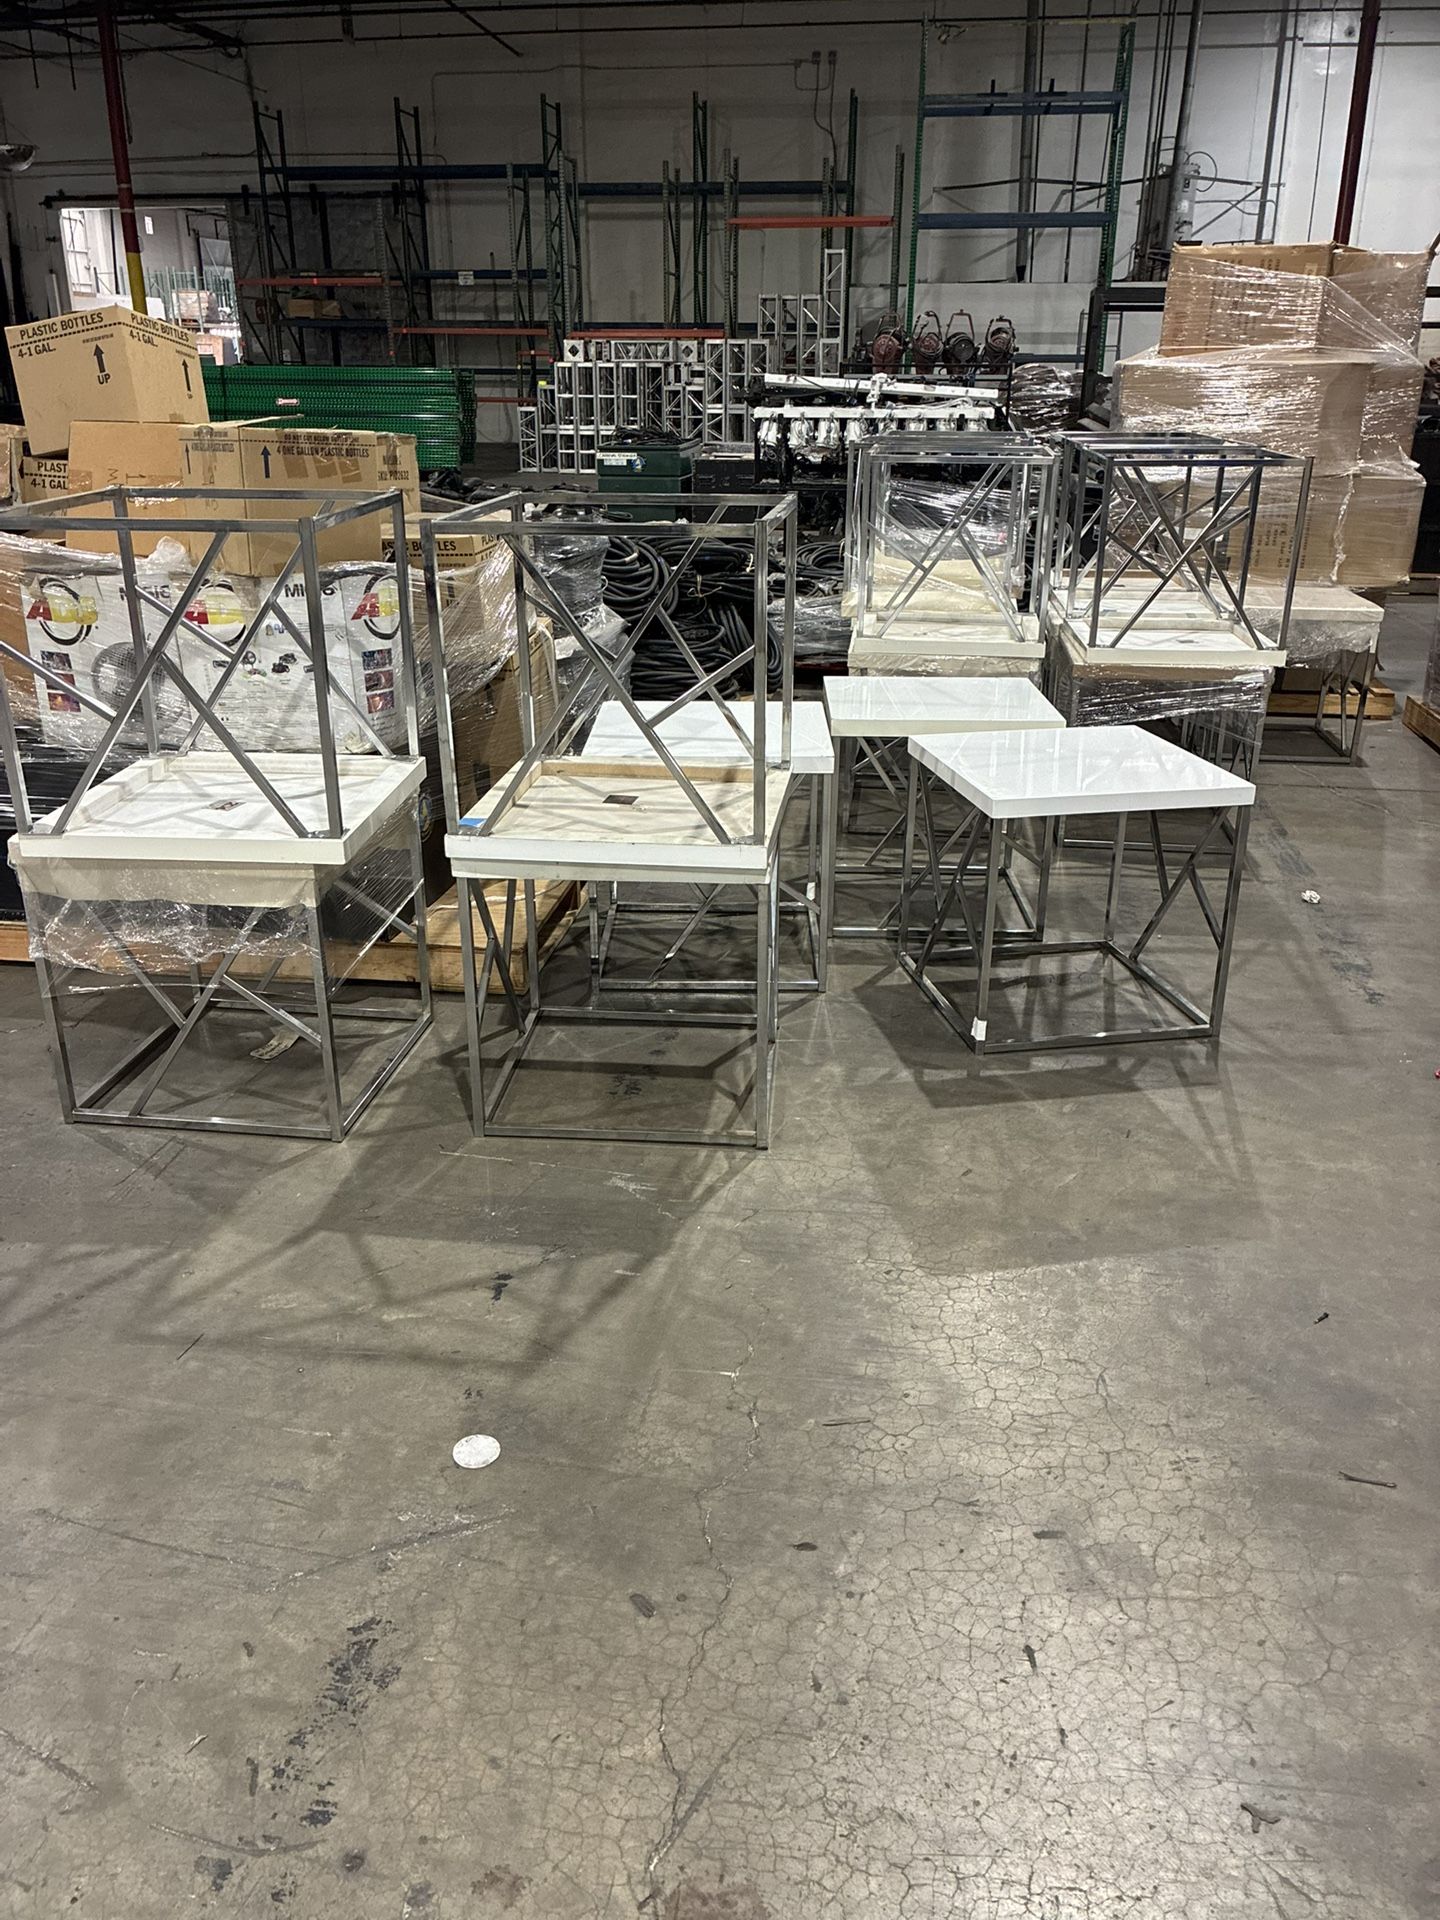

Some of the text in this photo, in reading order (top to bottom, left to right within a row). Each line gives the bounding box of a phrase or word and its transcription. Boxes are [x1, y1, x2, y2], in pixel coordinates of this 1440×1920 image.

[20, 312, 104, 340] PLASTIC BOTTLES
[131, 312, 190, 342] PLASTIC BOTTLES
[130, 329, 142, 342] 4-1
[142, 334, 158, 348] GAL.
[18, 342, 56, 358] 4-1 GAL.
[97, 374, 111, 385] UP
[276, 446, 370, 458] 4 ONE GALLON PLASTIC BOTTLES
[30, 478, 47, 488] 4-1
